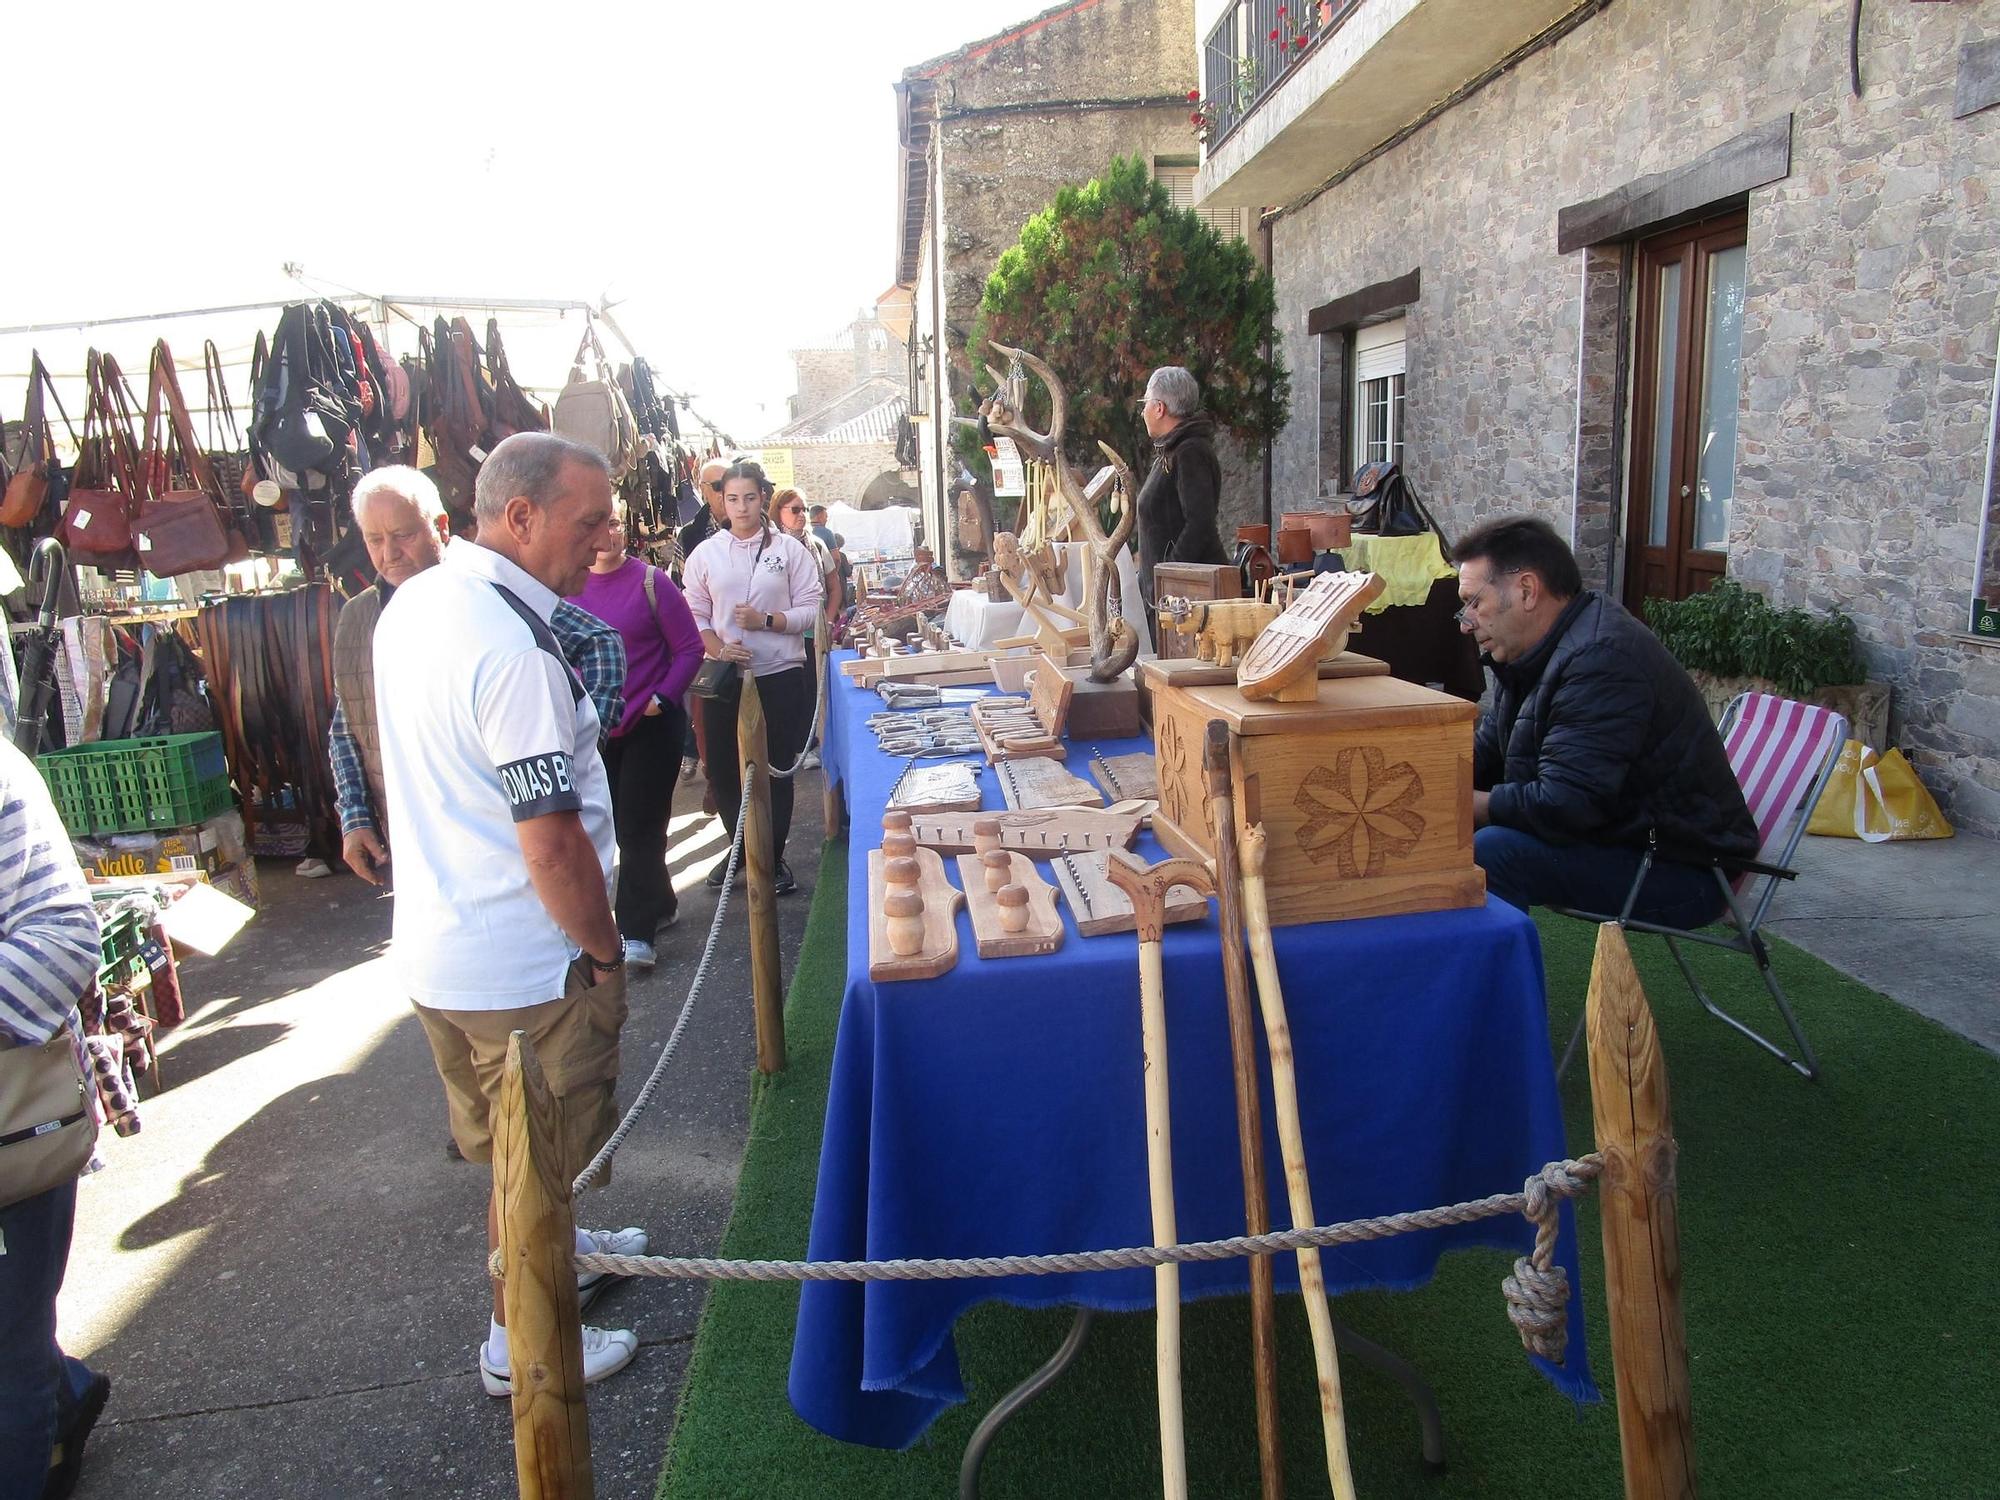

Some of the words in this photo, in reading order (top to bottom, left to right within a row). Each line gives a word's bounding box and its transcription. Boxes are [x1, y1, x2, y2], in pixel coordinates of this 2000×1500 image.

[762, 455, 785, 465] 2025
[499, 758, 553, 806] OMAS
[96, 852, 147, 876] Valle
